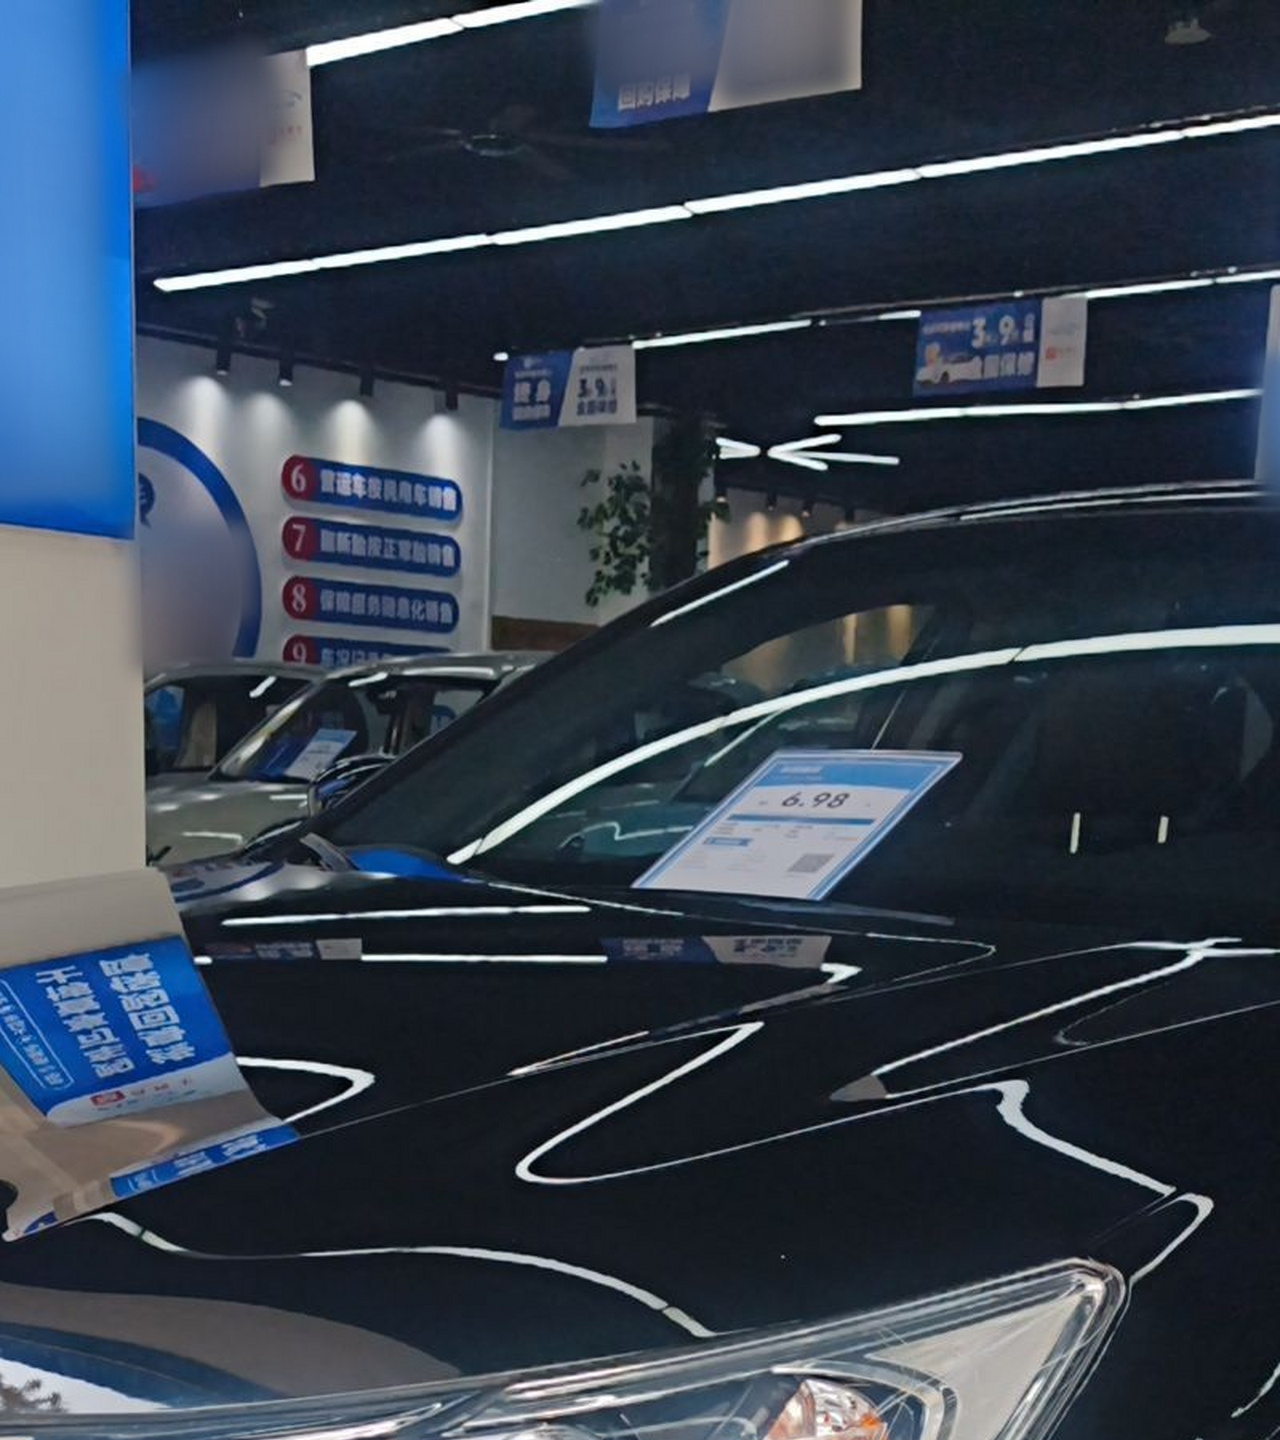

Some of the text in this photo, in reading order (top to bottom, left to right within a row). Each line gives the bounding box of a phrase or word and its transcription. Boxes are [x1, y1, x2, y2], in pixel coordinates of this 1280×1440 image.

[291, 464, 307, 492] 6
[292, 525, 308, 552] 7
[291, 584, 307, 612] 8
[292, 643, 307, 665] 9
[781, 791, 850, 808] 6.98
